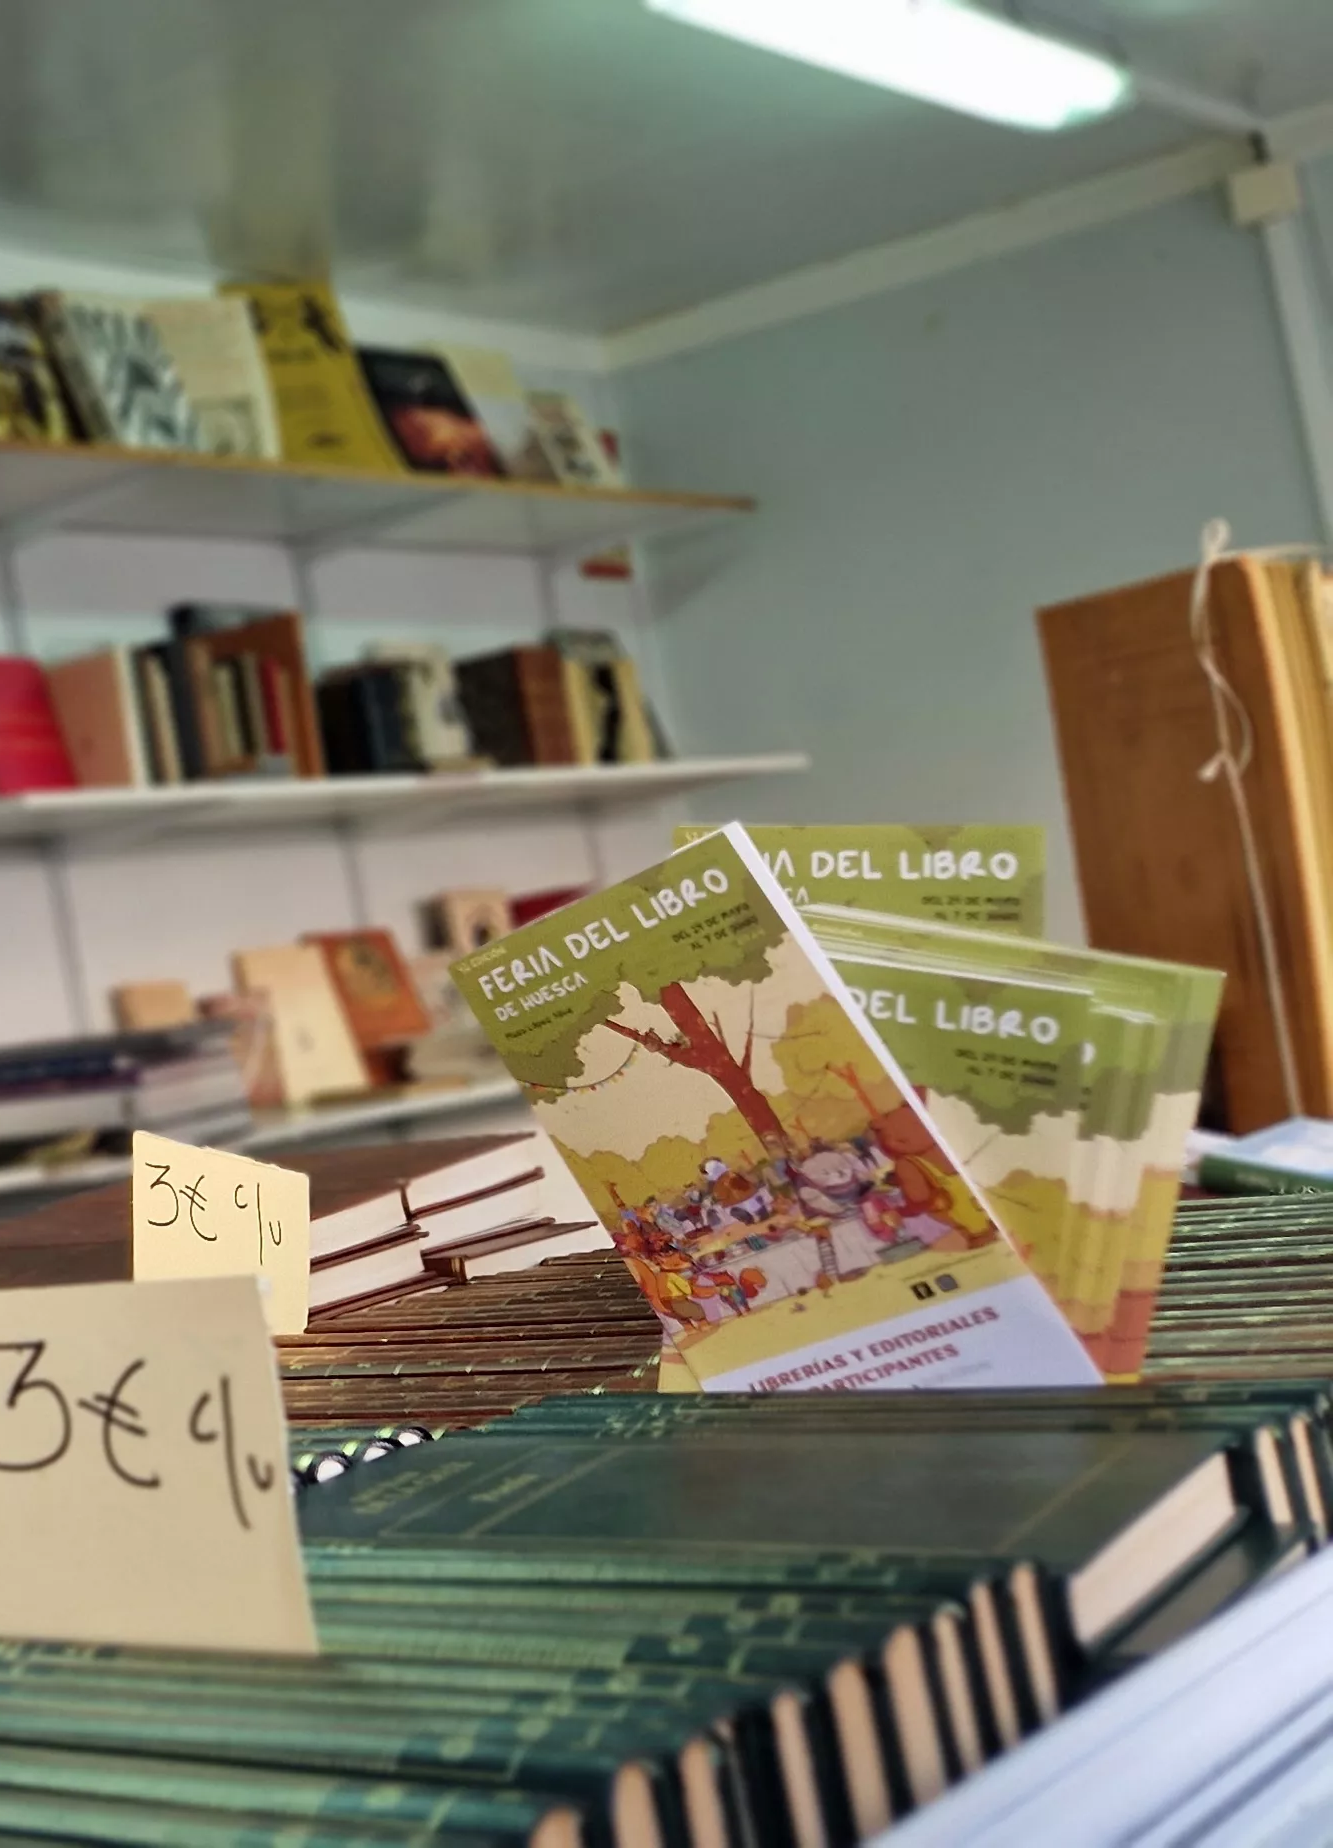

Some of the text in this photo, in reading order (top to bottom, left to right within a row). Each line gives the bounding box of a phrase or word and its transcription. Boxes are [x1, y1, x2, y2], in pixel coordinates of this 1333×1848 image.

[811, 850, 882, 880] DEL
[899, 850, 1019, 880] LIBRO
[477, 868, 729, 1000] FERIA DEL LIBRO
[494, 971, 589, 1022] DE HUESCA
[936, 1000, 1059, 1044] LIBRO
[144, 1161, 218, 1241] 3€
[748, 1306, 1000, 1392] LIBRERÍAS Y EDITORIALES
